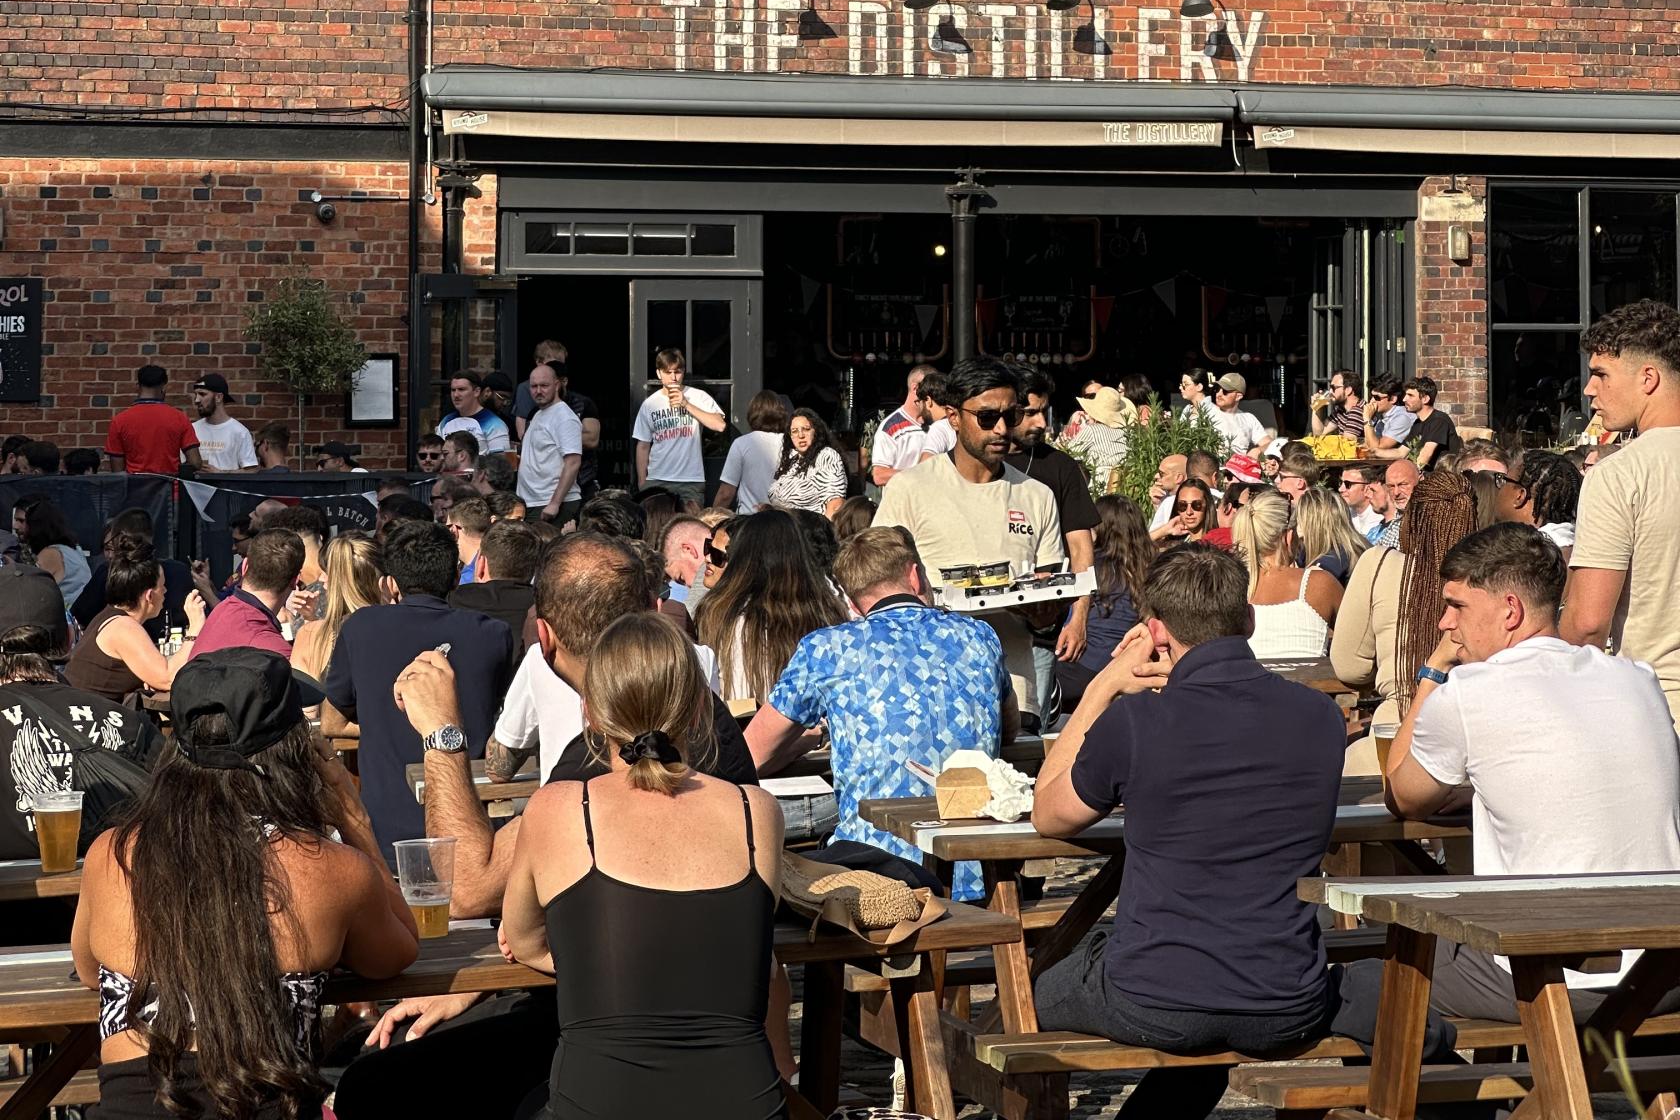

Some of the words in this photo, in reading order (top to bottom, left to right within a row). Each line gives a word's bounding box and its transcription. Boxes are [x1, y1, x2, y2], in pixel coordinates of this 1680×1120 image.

[849, 1, 1265, 82] DISTILLERY
[1103, 122, 1131, 143] THE
[1135, 121, 1216, 143] DISTILLERY
[654, 426, 693, 442] CHAMPION
[338, 506, 369, 527] BATCH
[1008, 522, 1034, 536] Rice
[1, 705, 124, 728] VNS
